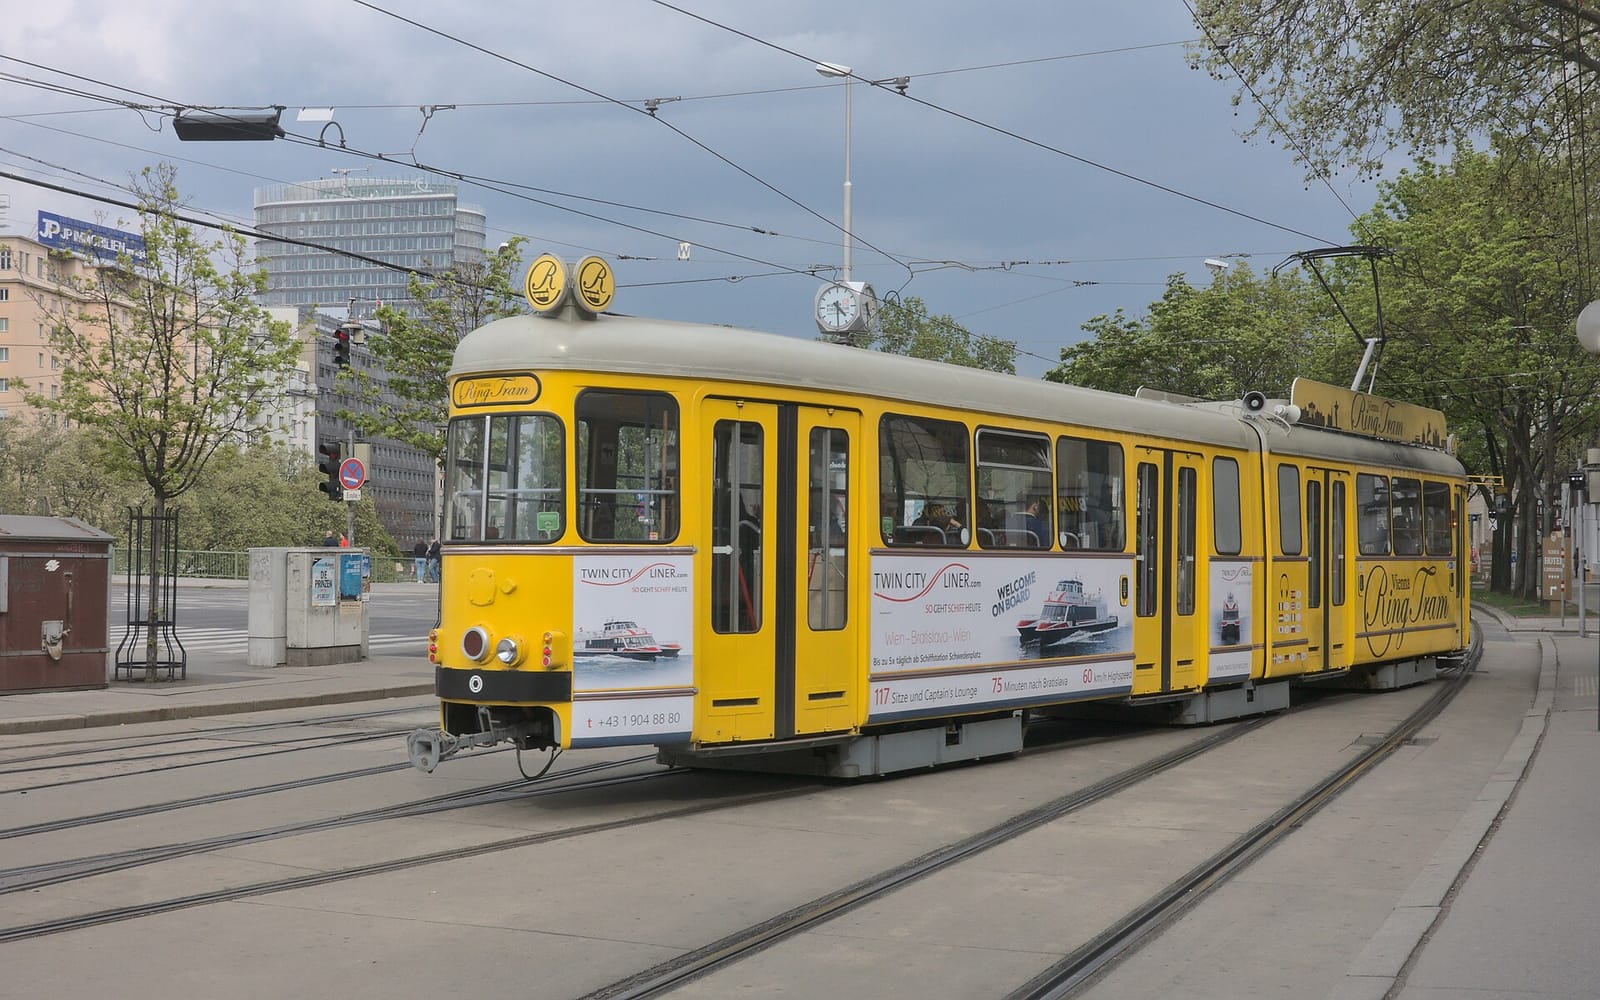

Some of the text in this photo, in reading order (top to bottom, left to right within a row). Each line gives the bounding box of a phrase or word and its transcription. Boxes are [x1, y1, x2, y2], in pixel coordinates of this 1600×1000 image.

[39, 218, 60, 239] JP
[60, 228, 73, 240] JP
[459, 377, 528, 404] Ring Tram
[1351, 393, 1404, 436] Ring Tram
[581, 568, 609, 578] TWIN
[612, 568, 633, 578] CITY
[874, 572, 903, 589] TWIN
[905, 572, 927, 589] CITY
[996, 571, 1036, 600] WELCOME
[1392, 574, 1410, 590] Vienna
[925, 602, 981, 614] SO GEHT SCHIFF HEUTE
[991, 589, 1031, 617] ON BOARD
[1364, 565, 1449, 657] Ring Tram
[873, 657, 881, 666] Bis
[888, 656, 895, 665] 5x
[896, 655, 912, 666] täglich
[912, 655, 920, 663] ab
[1083, 668, 1093, 684] 60
[991, 676, 1069, 694] 75 Minuten nach Bratislava
[874, 688, 890, 705] 117
[891, 691, 908, 704] Sitze
[909, 689, 923, 702] und
[954, 686, 978, 700] Lounge
[586, 712, 681, 728] t +43 1 904 88 80
